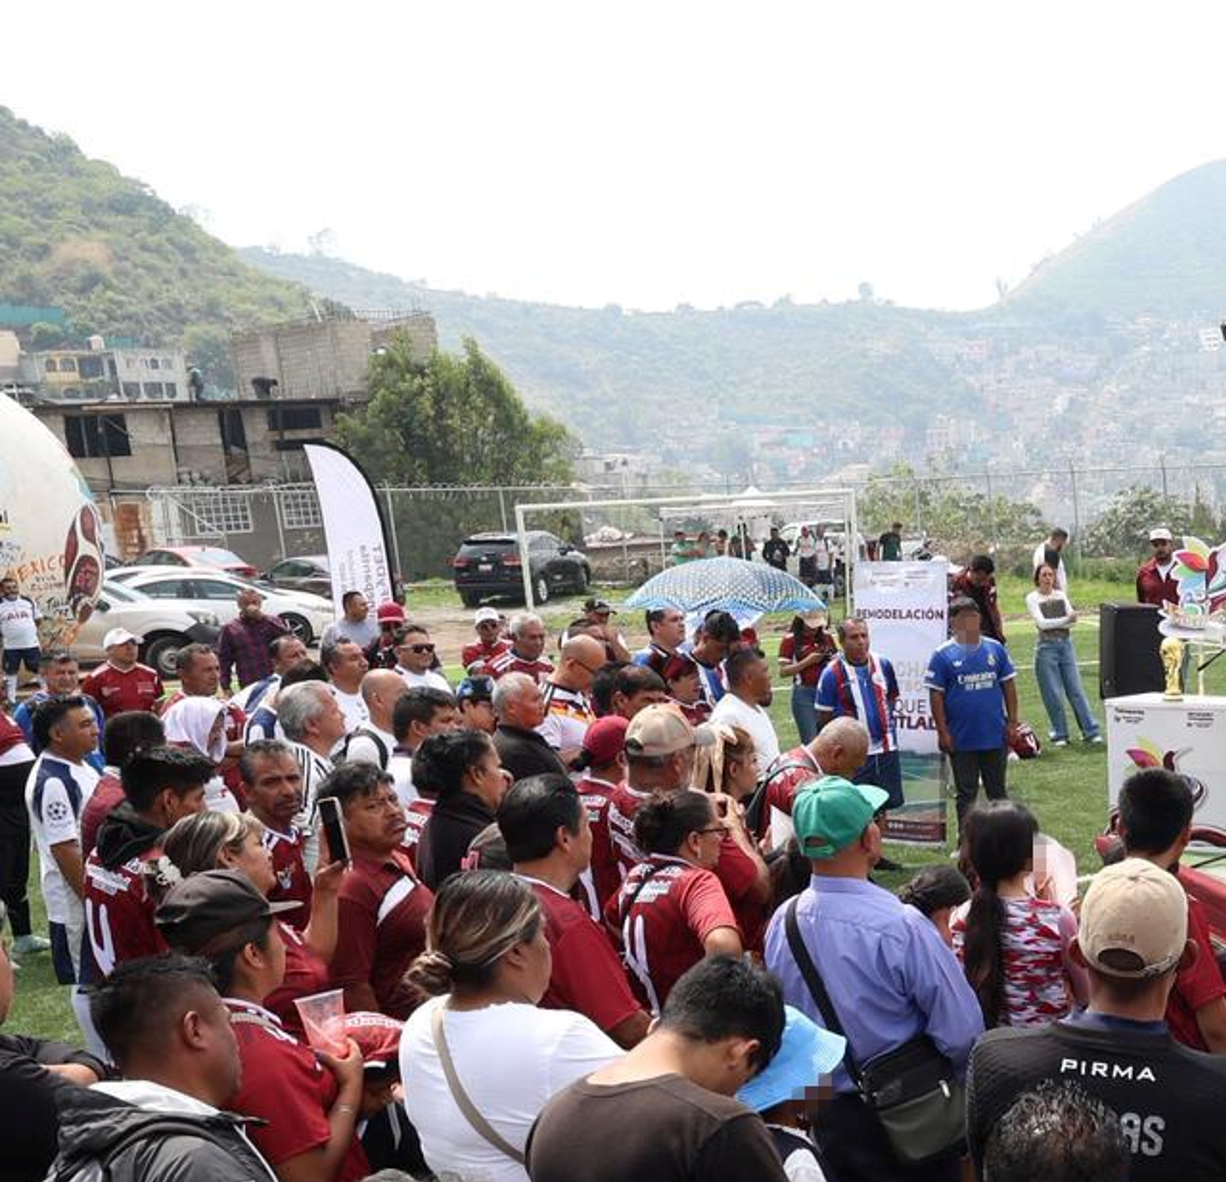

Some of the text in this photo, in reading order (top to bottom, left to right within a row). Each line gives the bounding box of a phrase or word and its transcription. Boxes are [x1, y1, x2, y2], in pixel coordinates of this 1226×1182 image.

[856, 606, 944, 621] REMODELACIÓN
[894, 698, 927, 714] QUE
[1060, 1058, 1156, 1082] PIRMA
